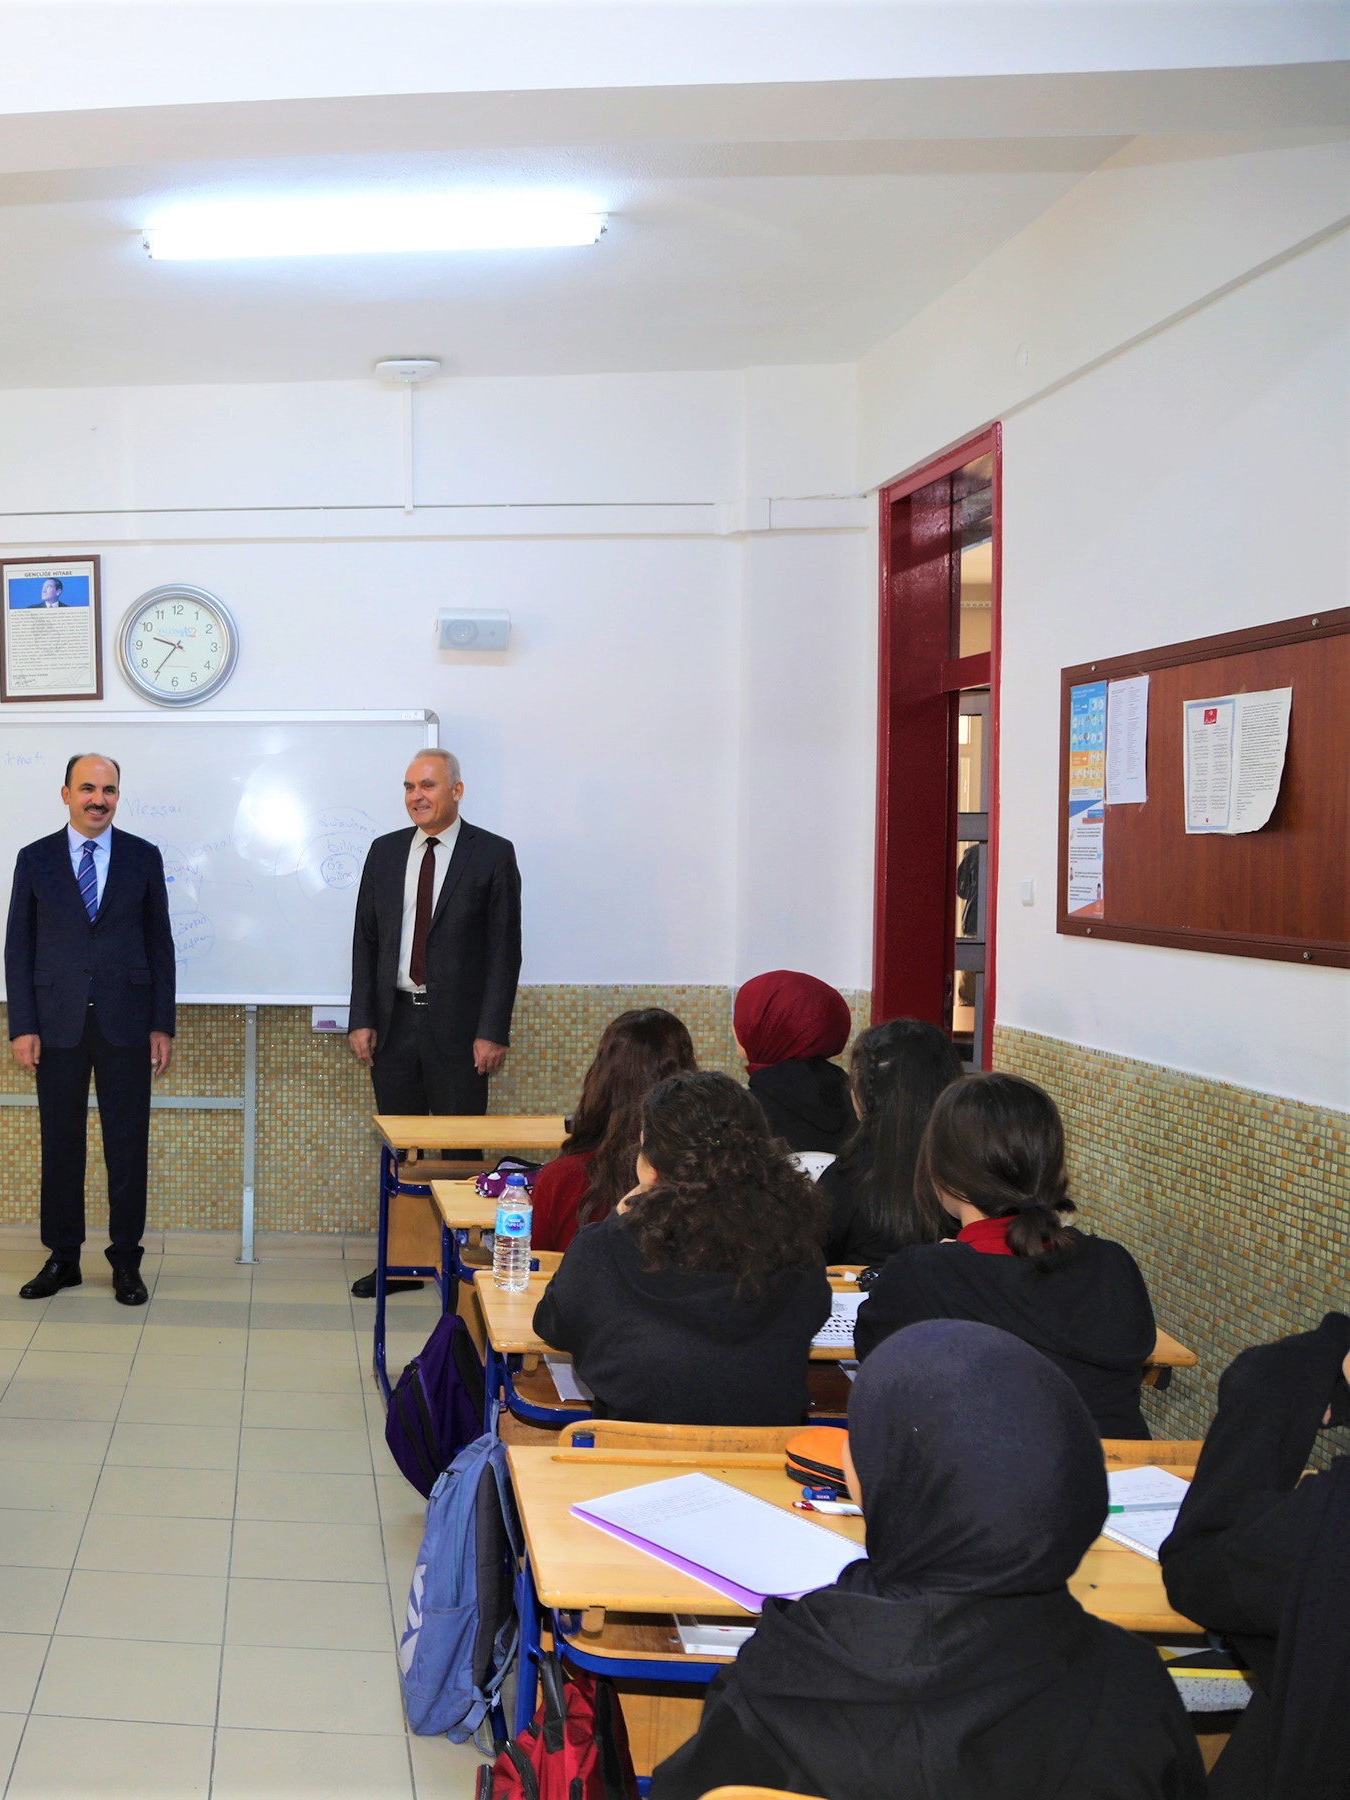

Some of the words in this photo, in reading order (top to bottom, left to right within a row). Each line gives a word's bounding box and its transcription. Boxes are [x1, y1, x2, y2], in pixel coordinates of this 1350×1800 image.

[155, 610, 165, 620] 11
[172, 605, 184, 615] 12
[194, 611, 199, 621] 1
[142, 622, 153, 632] 10
[205, 624, 213, 634] 2
[136, 640, 143, 650] 9
[210, 642, 218, 653] 3
[141, 658, 148, 668] 8
[204, 660, 211, 670] 4
[154, 671, 161, 681] 7
[190, 672, 198, 683] 5
[171, 676, 179, 687] 6
